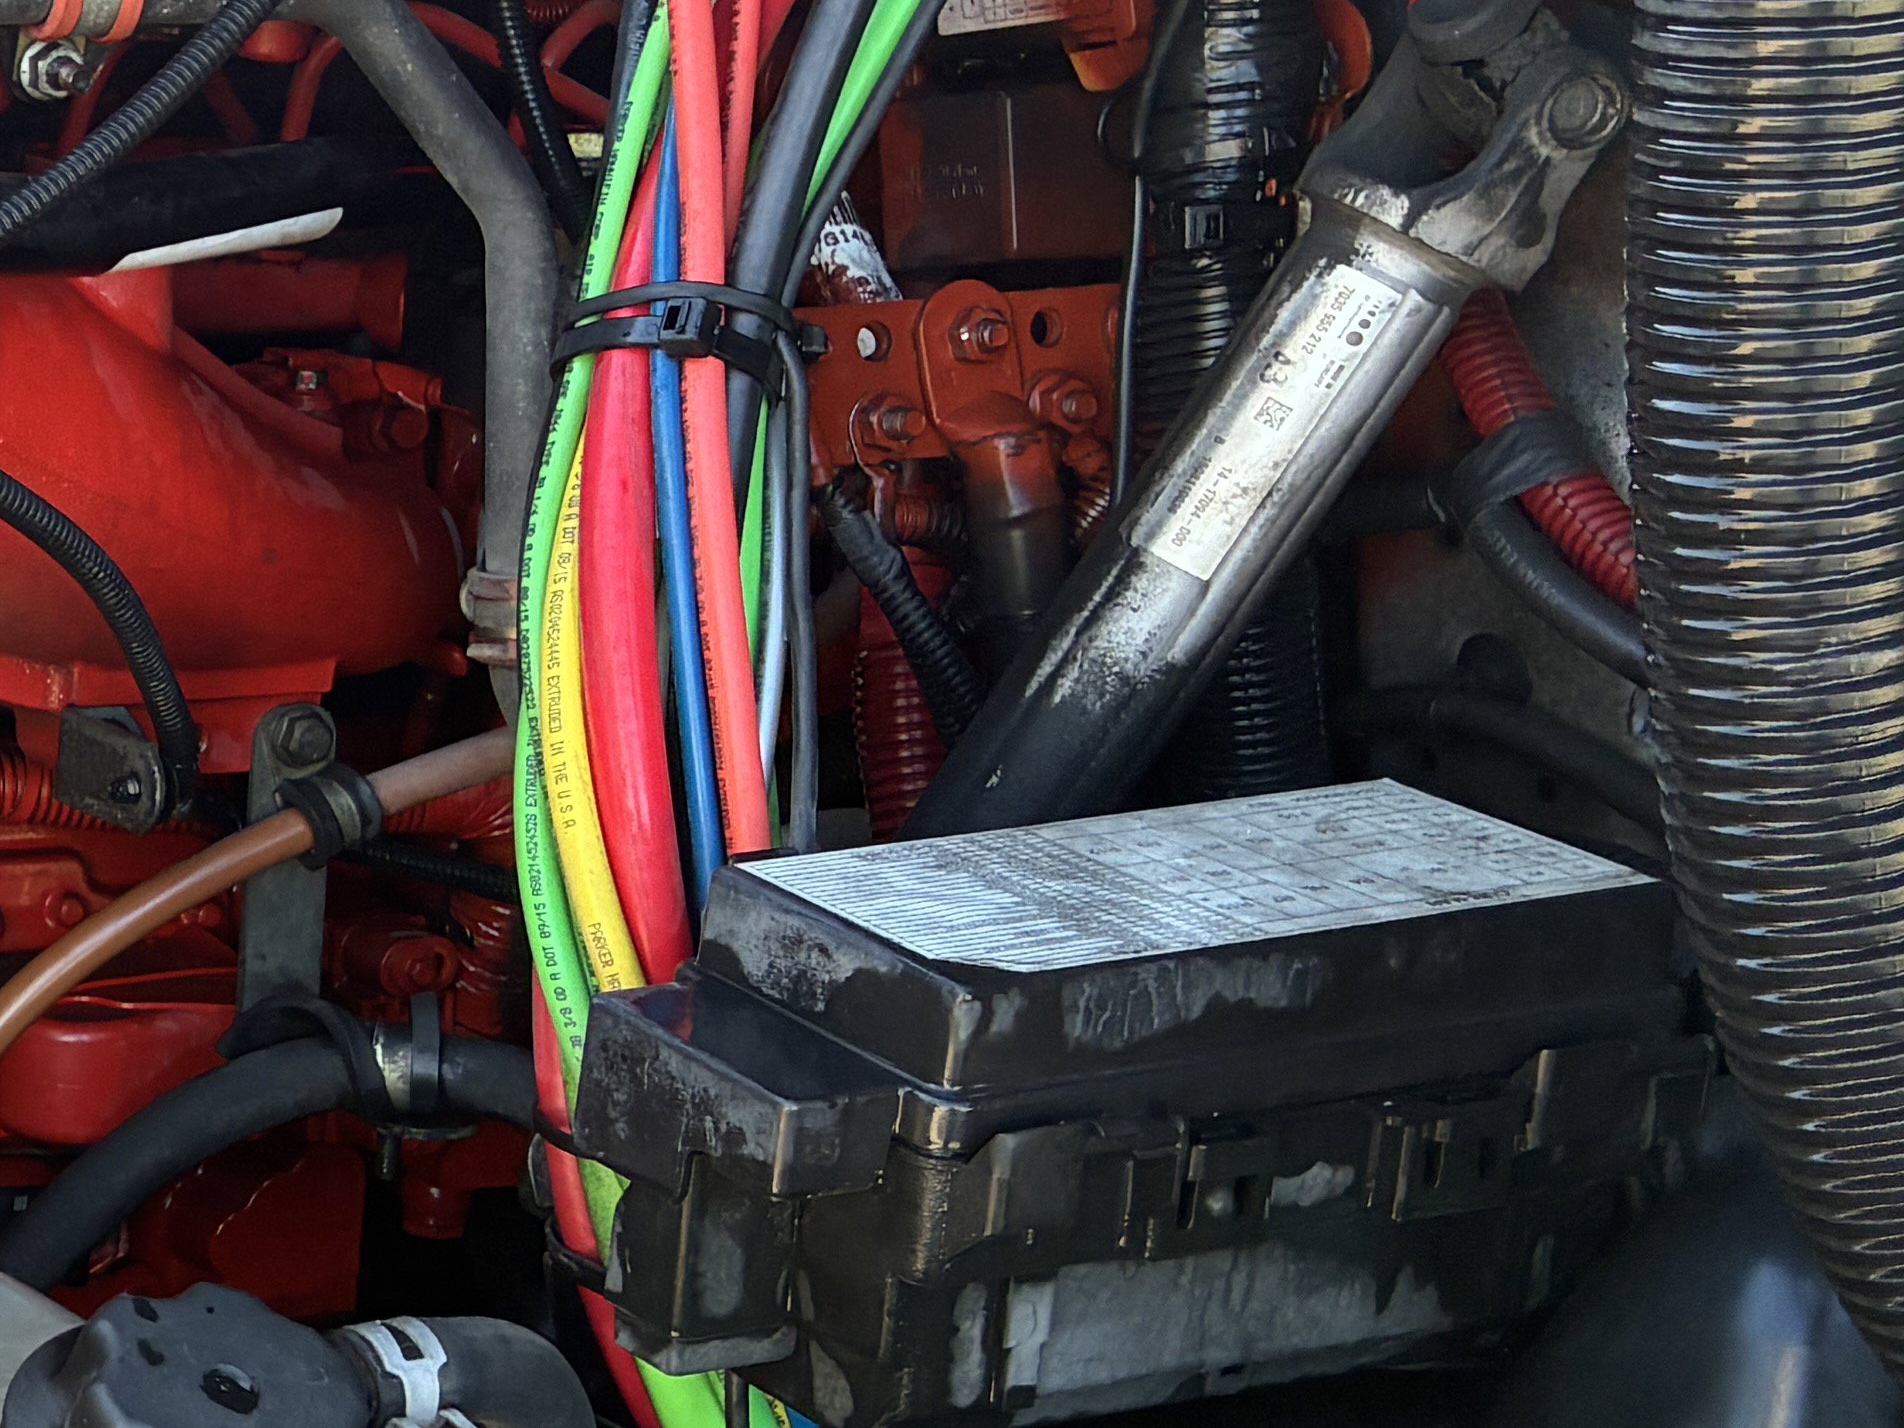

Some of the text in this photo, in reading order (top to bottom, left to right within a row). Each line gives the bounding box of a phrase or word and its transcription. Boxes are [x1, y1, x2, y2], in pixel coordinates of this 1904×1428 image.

[546, 675, 561, 734] EXTRUDED
[549, 741, 565, 758] IN
[553, 761, 569, 784] THE
[542, 945, 556, 968] DOT
[588, 923, 614, 968] PARKER
[550, 972, 562, 981] A
